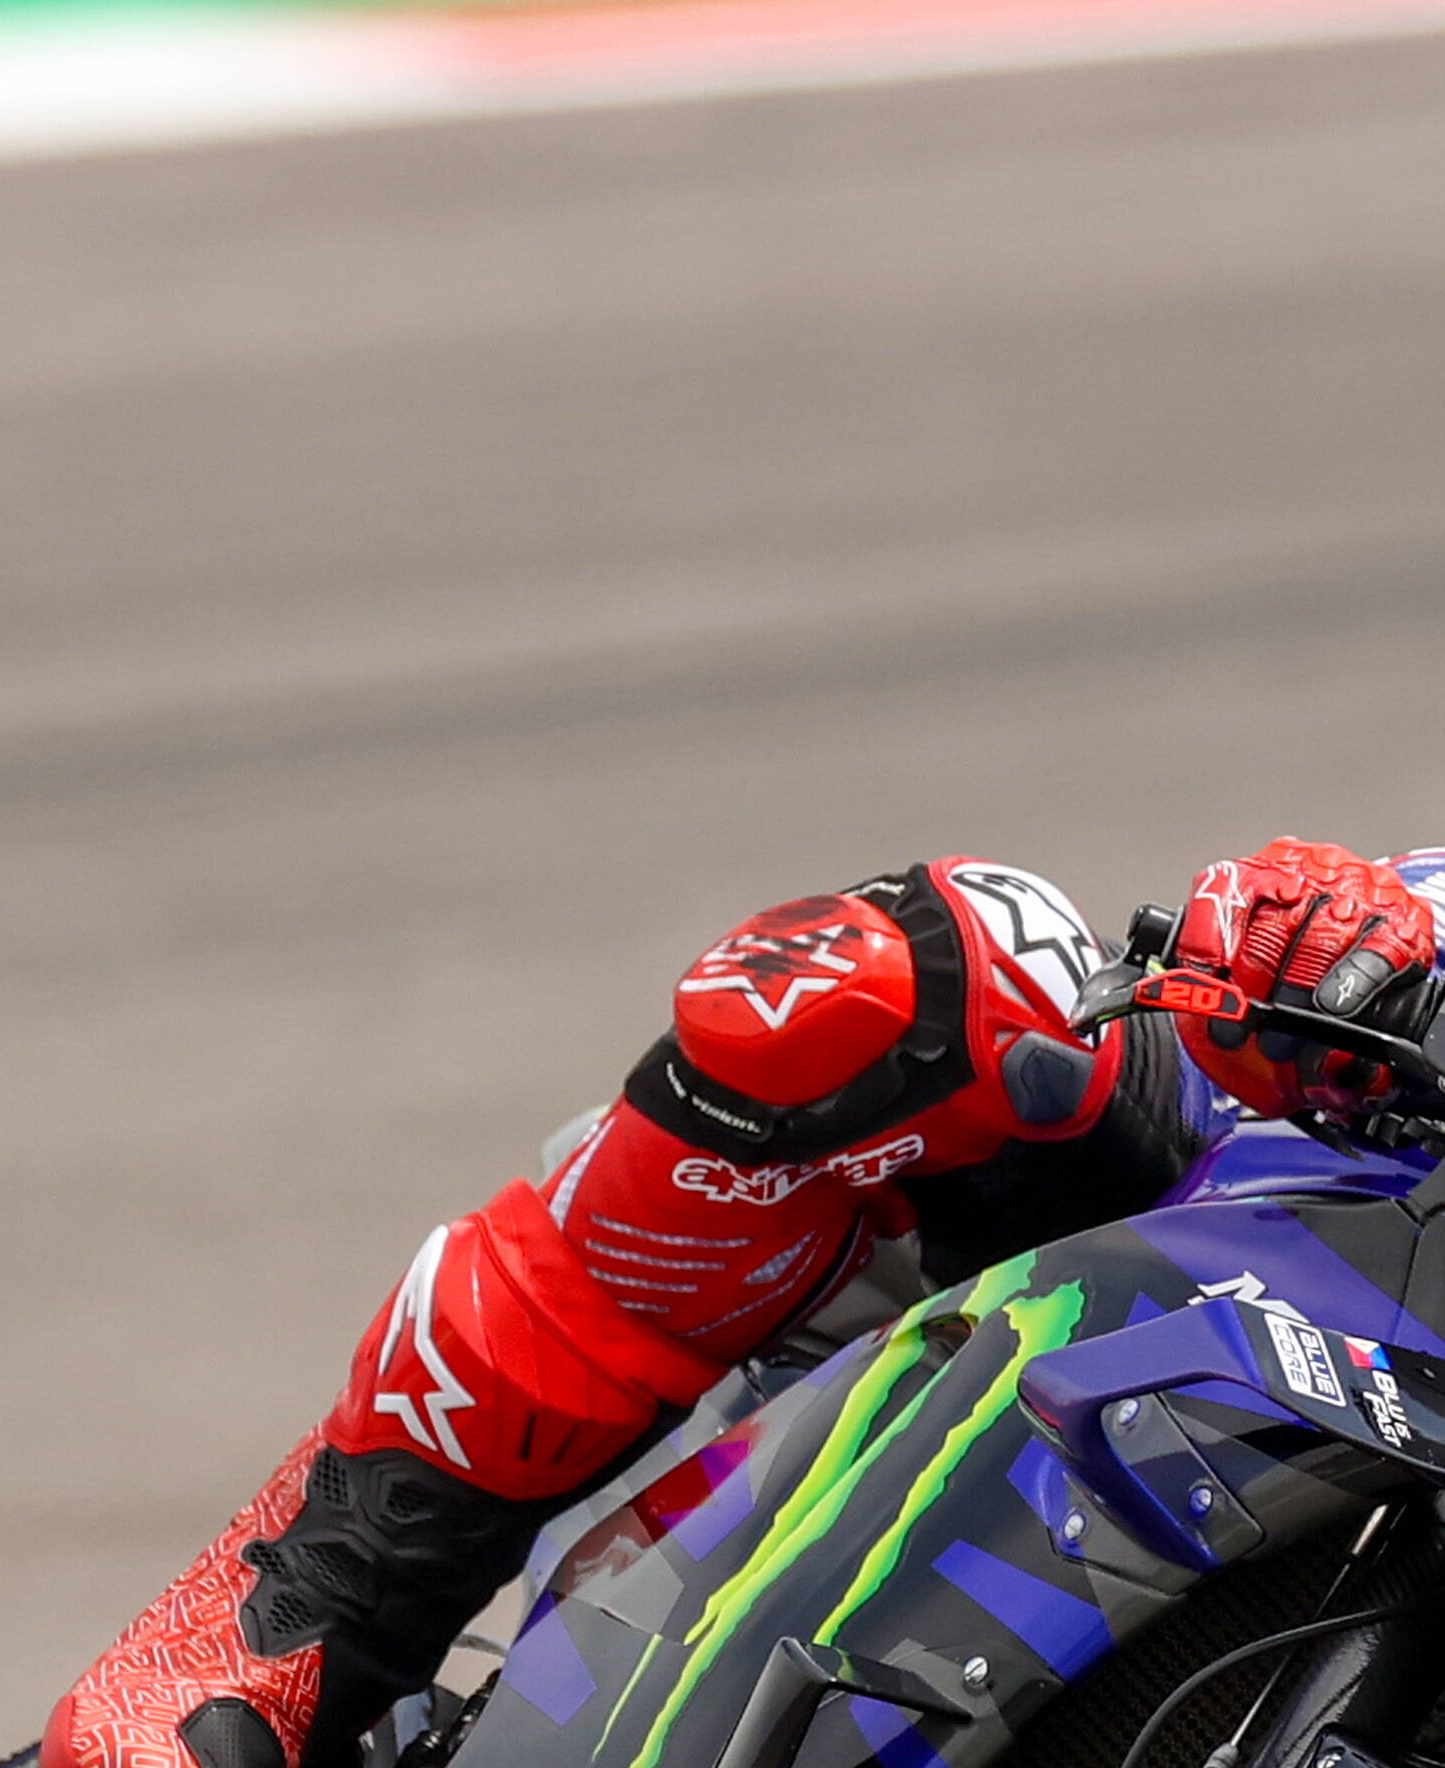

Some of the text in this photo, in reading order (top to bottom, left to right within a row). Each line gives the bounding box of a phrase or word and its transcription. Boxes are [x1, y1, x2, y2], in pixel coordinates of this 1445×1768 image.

[1273, 1324, 1307, 1386] CORE
[1300, 1330, 1337, 1402] BLUE
[1363, 1391, 1402, 1449] FAST
